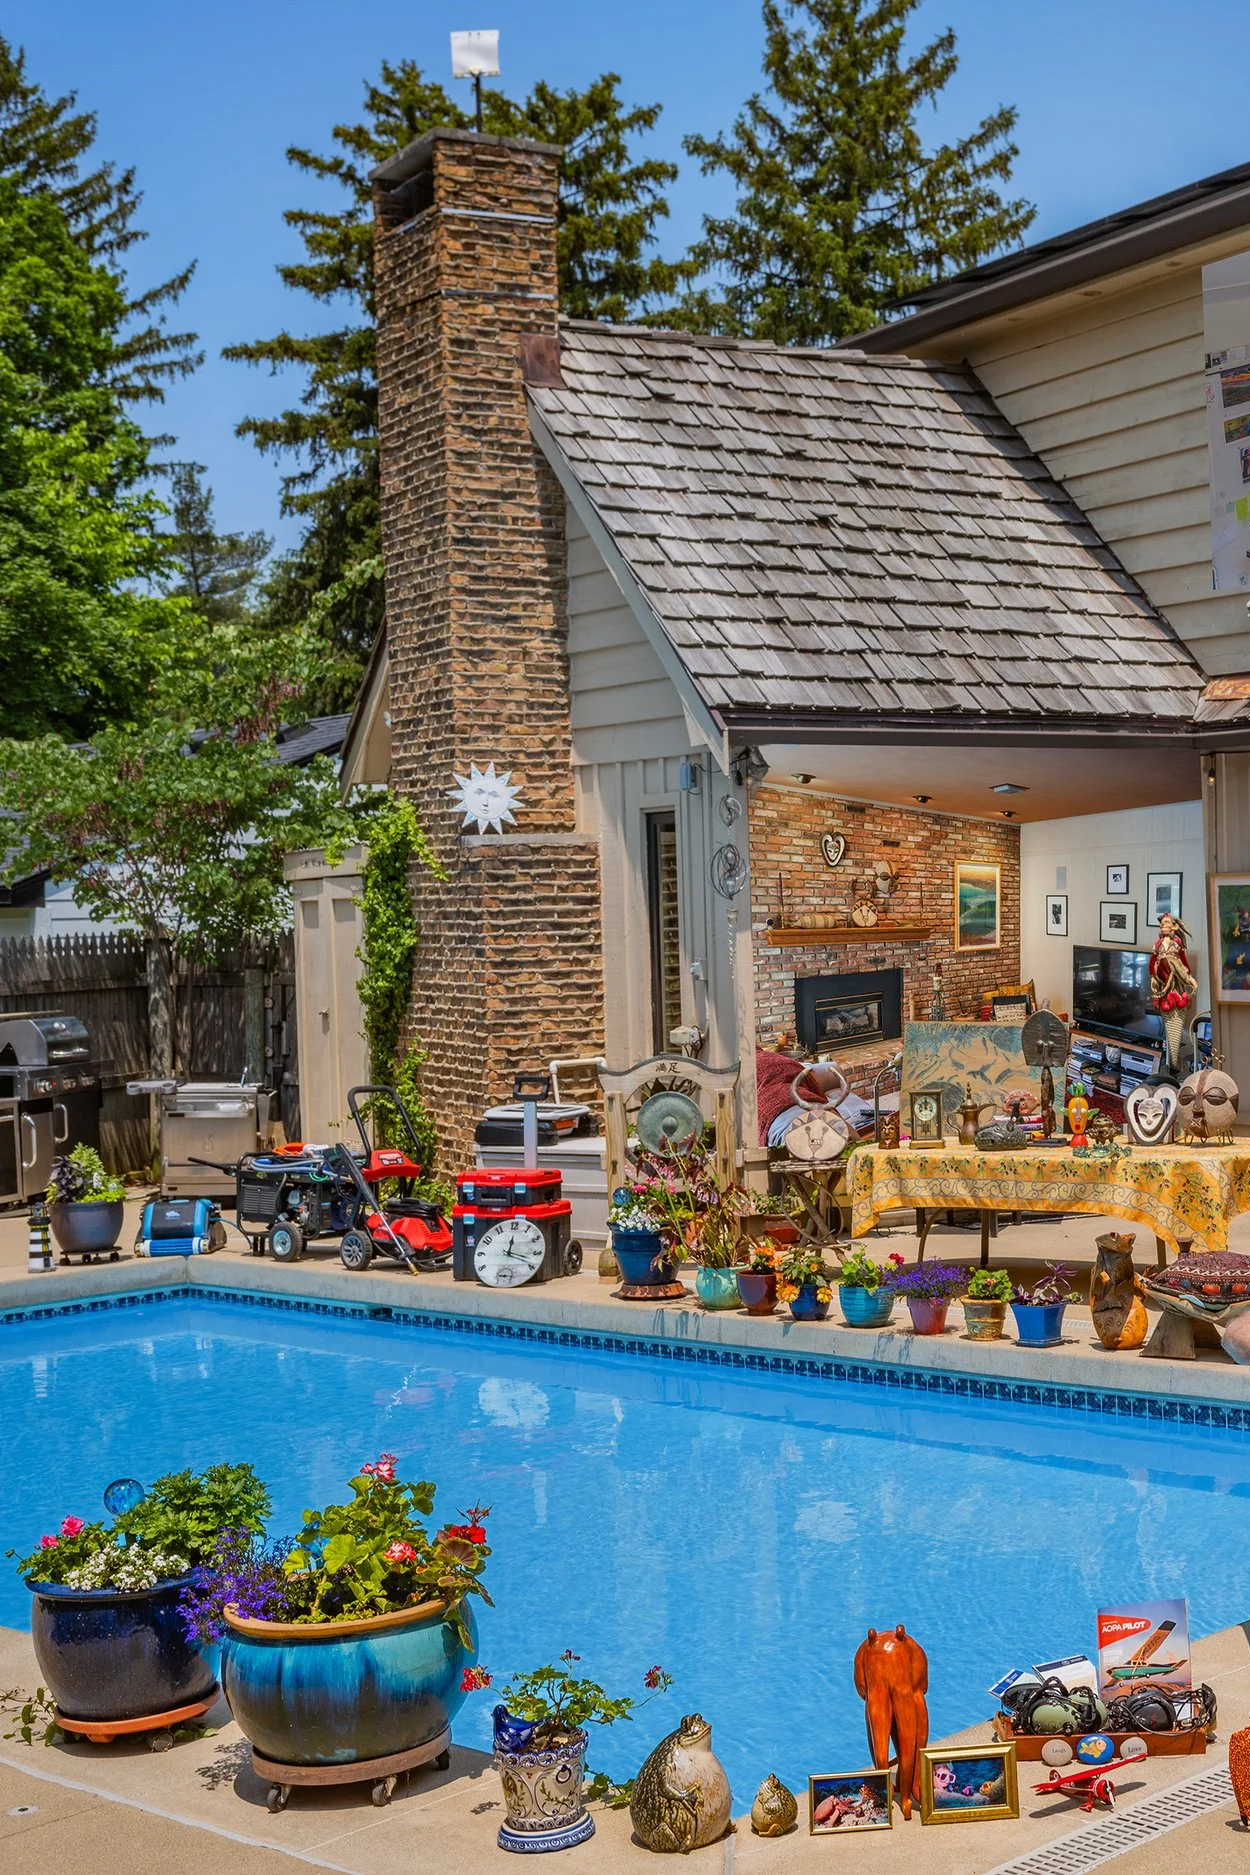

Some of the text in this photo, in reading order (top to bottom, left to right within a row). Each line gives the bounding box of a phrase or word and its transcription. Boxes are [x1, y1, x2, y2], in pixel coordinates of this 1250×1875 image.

[495, 1225, 504, 1235] 11
[510, 1222, 519, 1231] 12
[524, 1225, 532, 1234] 1
[483, 1236, 493, 1246] 10
[532, 1235, 541, 1243] 2
[478, 1264, 487, 1272] 8
[1102, 1624, 1123, 1633] AOPA
[1122, 1621, 1146, 1630] PILOT
